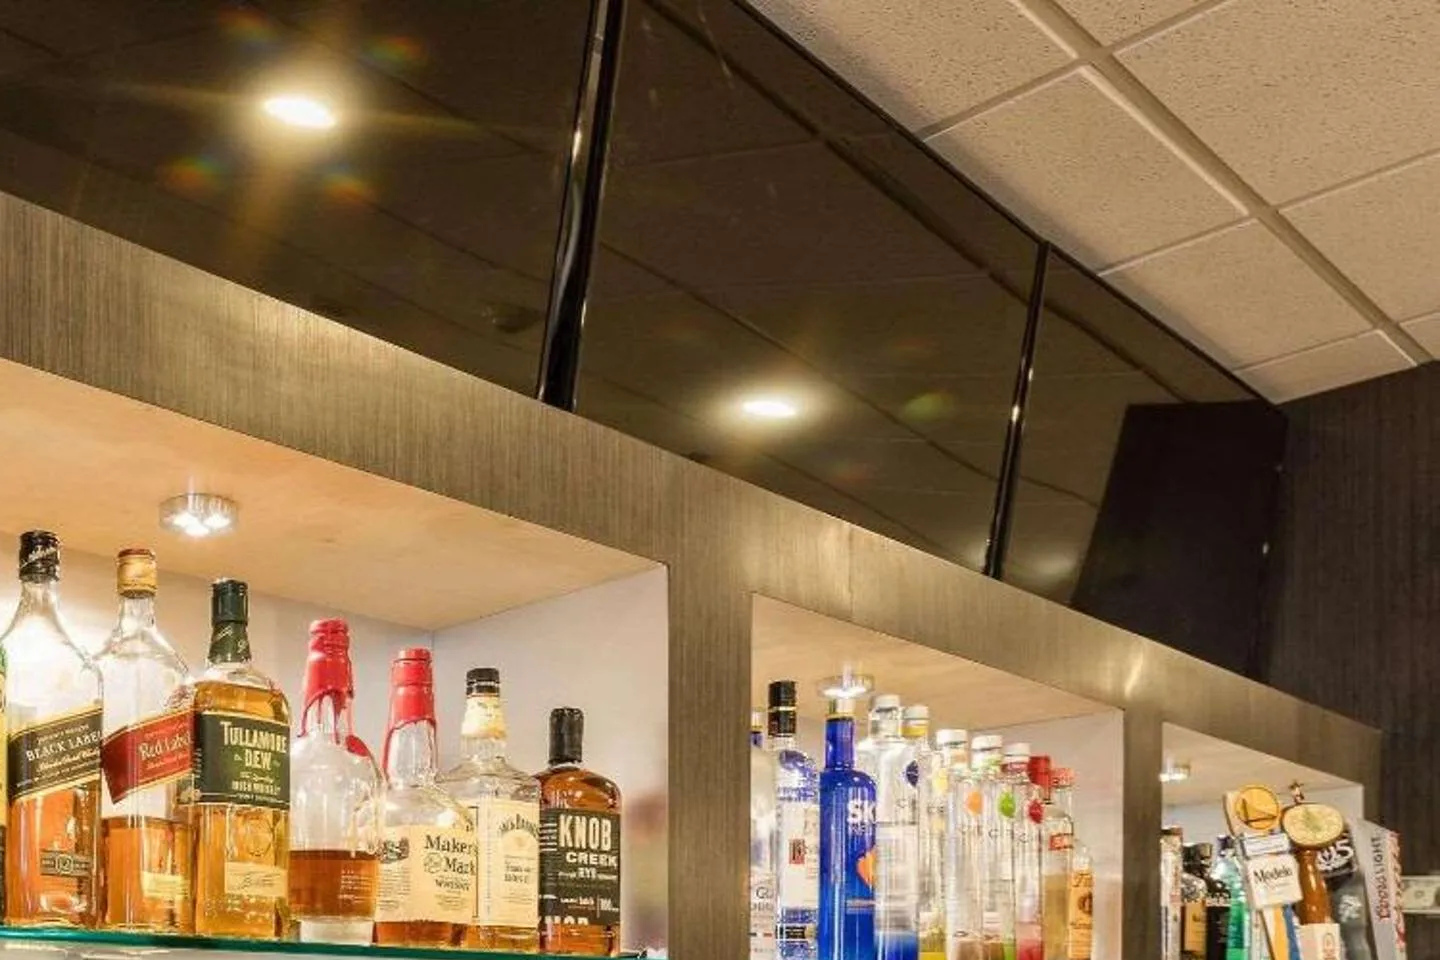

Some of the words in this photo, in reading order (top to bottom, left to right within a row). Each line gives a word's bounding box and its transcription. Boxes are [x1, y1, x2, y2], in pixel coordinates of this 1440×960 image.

[26, 741, 67, 762] BLACK
[559, 814, 612, 851] KNOB
[565, 852, 618, 869] CREEK
